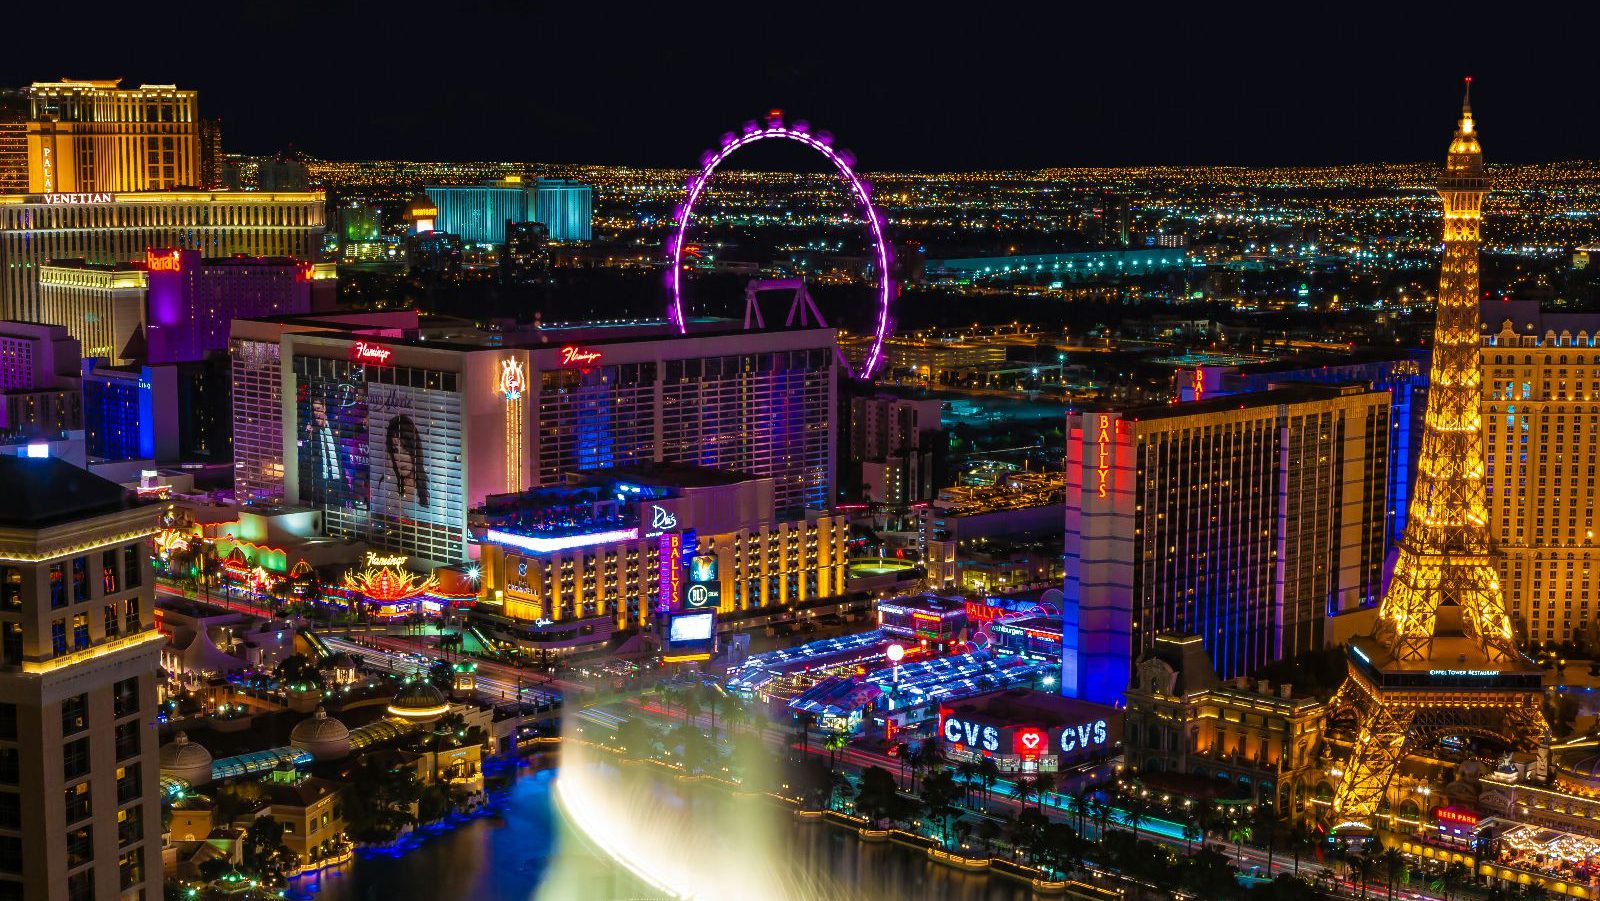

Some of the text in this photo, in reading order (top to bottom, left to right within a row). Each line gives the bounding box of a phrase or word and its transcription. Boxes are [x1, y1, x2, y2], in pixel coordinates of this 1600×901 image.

[44, 193, 111, 204] VENETIAN
[356, 342, 391, 363] Flamingo
[561, 347, 602, 364] Flamingo
[366, 551, 409, 570] Flamingo
[944, 718, 999, 751] CVS
[1060, 720, 1107, 752] CVS
[1438, 809, 1476, 825] BEER PARK
